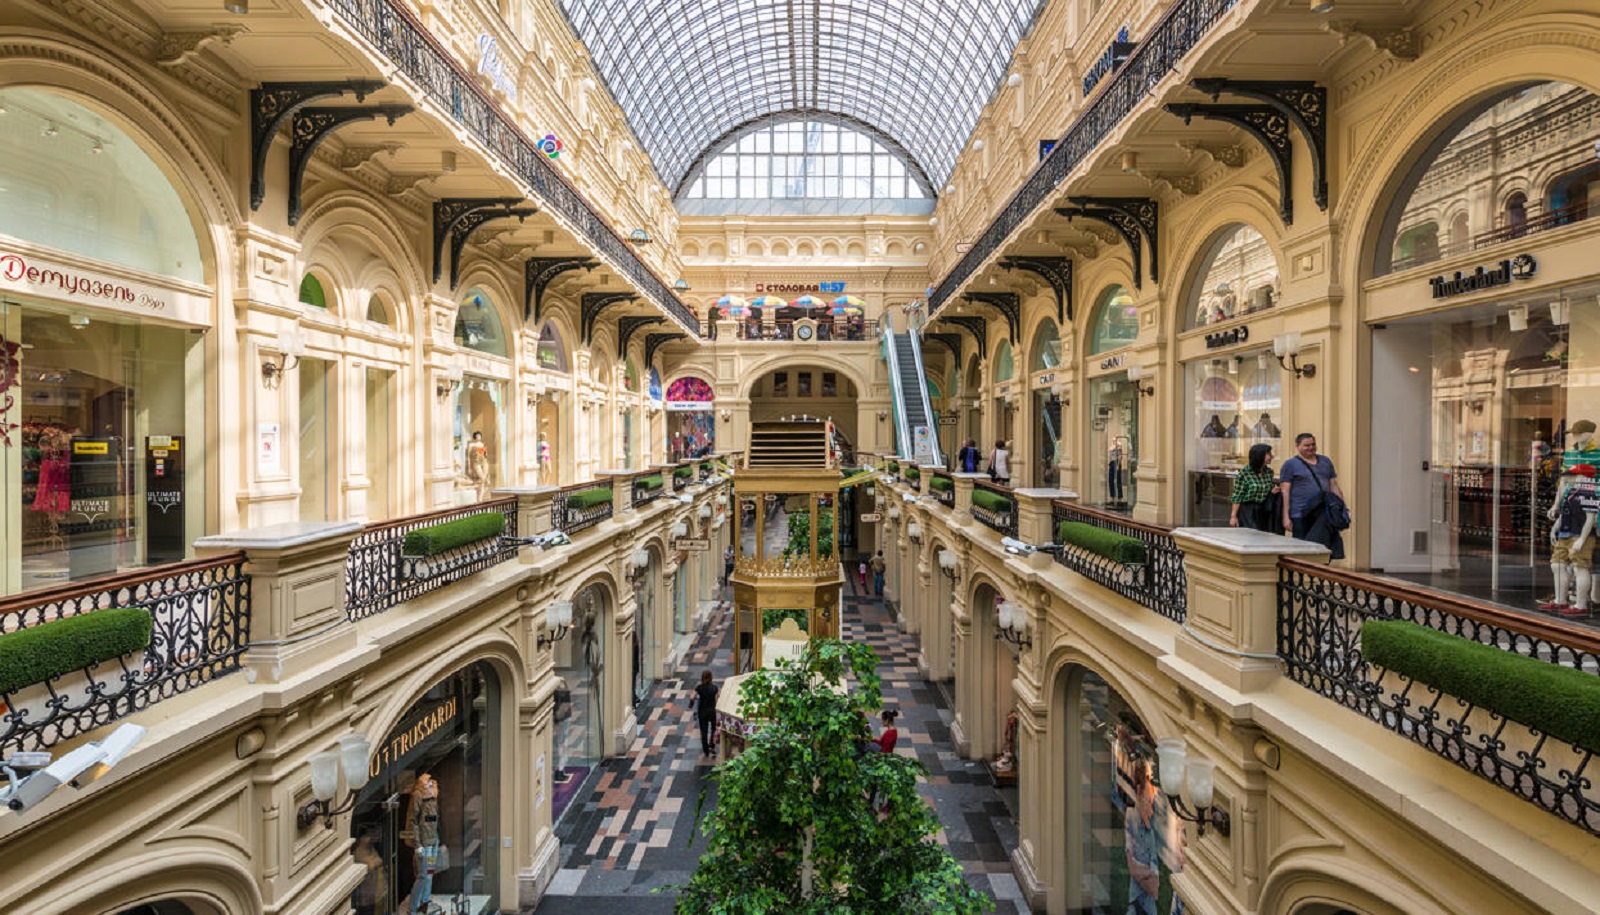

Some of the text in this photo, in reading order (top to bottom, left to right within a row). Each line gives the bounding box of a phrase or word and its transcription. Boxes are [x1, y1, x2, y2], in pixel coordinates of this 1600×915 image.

[766, 284, 819, 292] СТОЛОВАЯ
[1429, 260, 1510, 298] Timberland
[391, 696, 456, 762] TRUSSARDI
